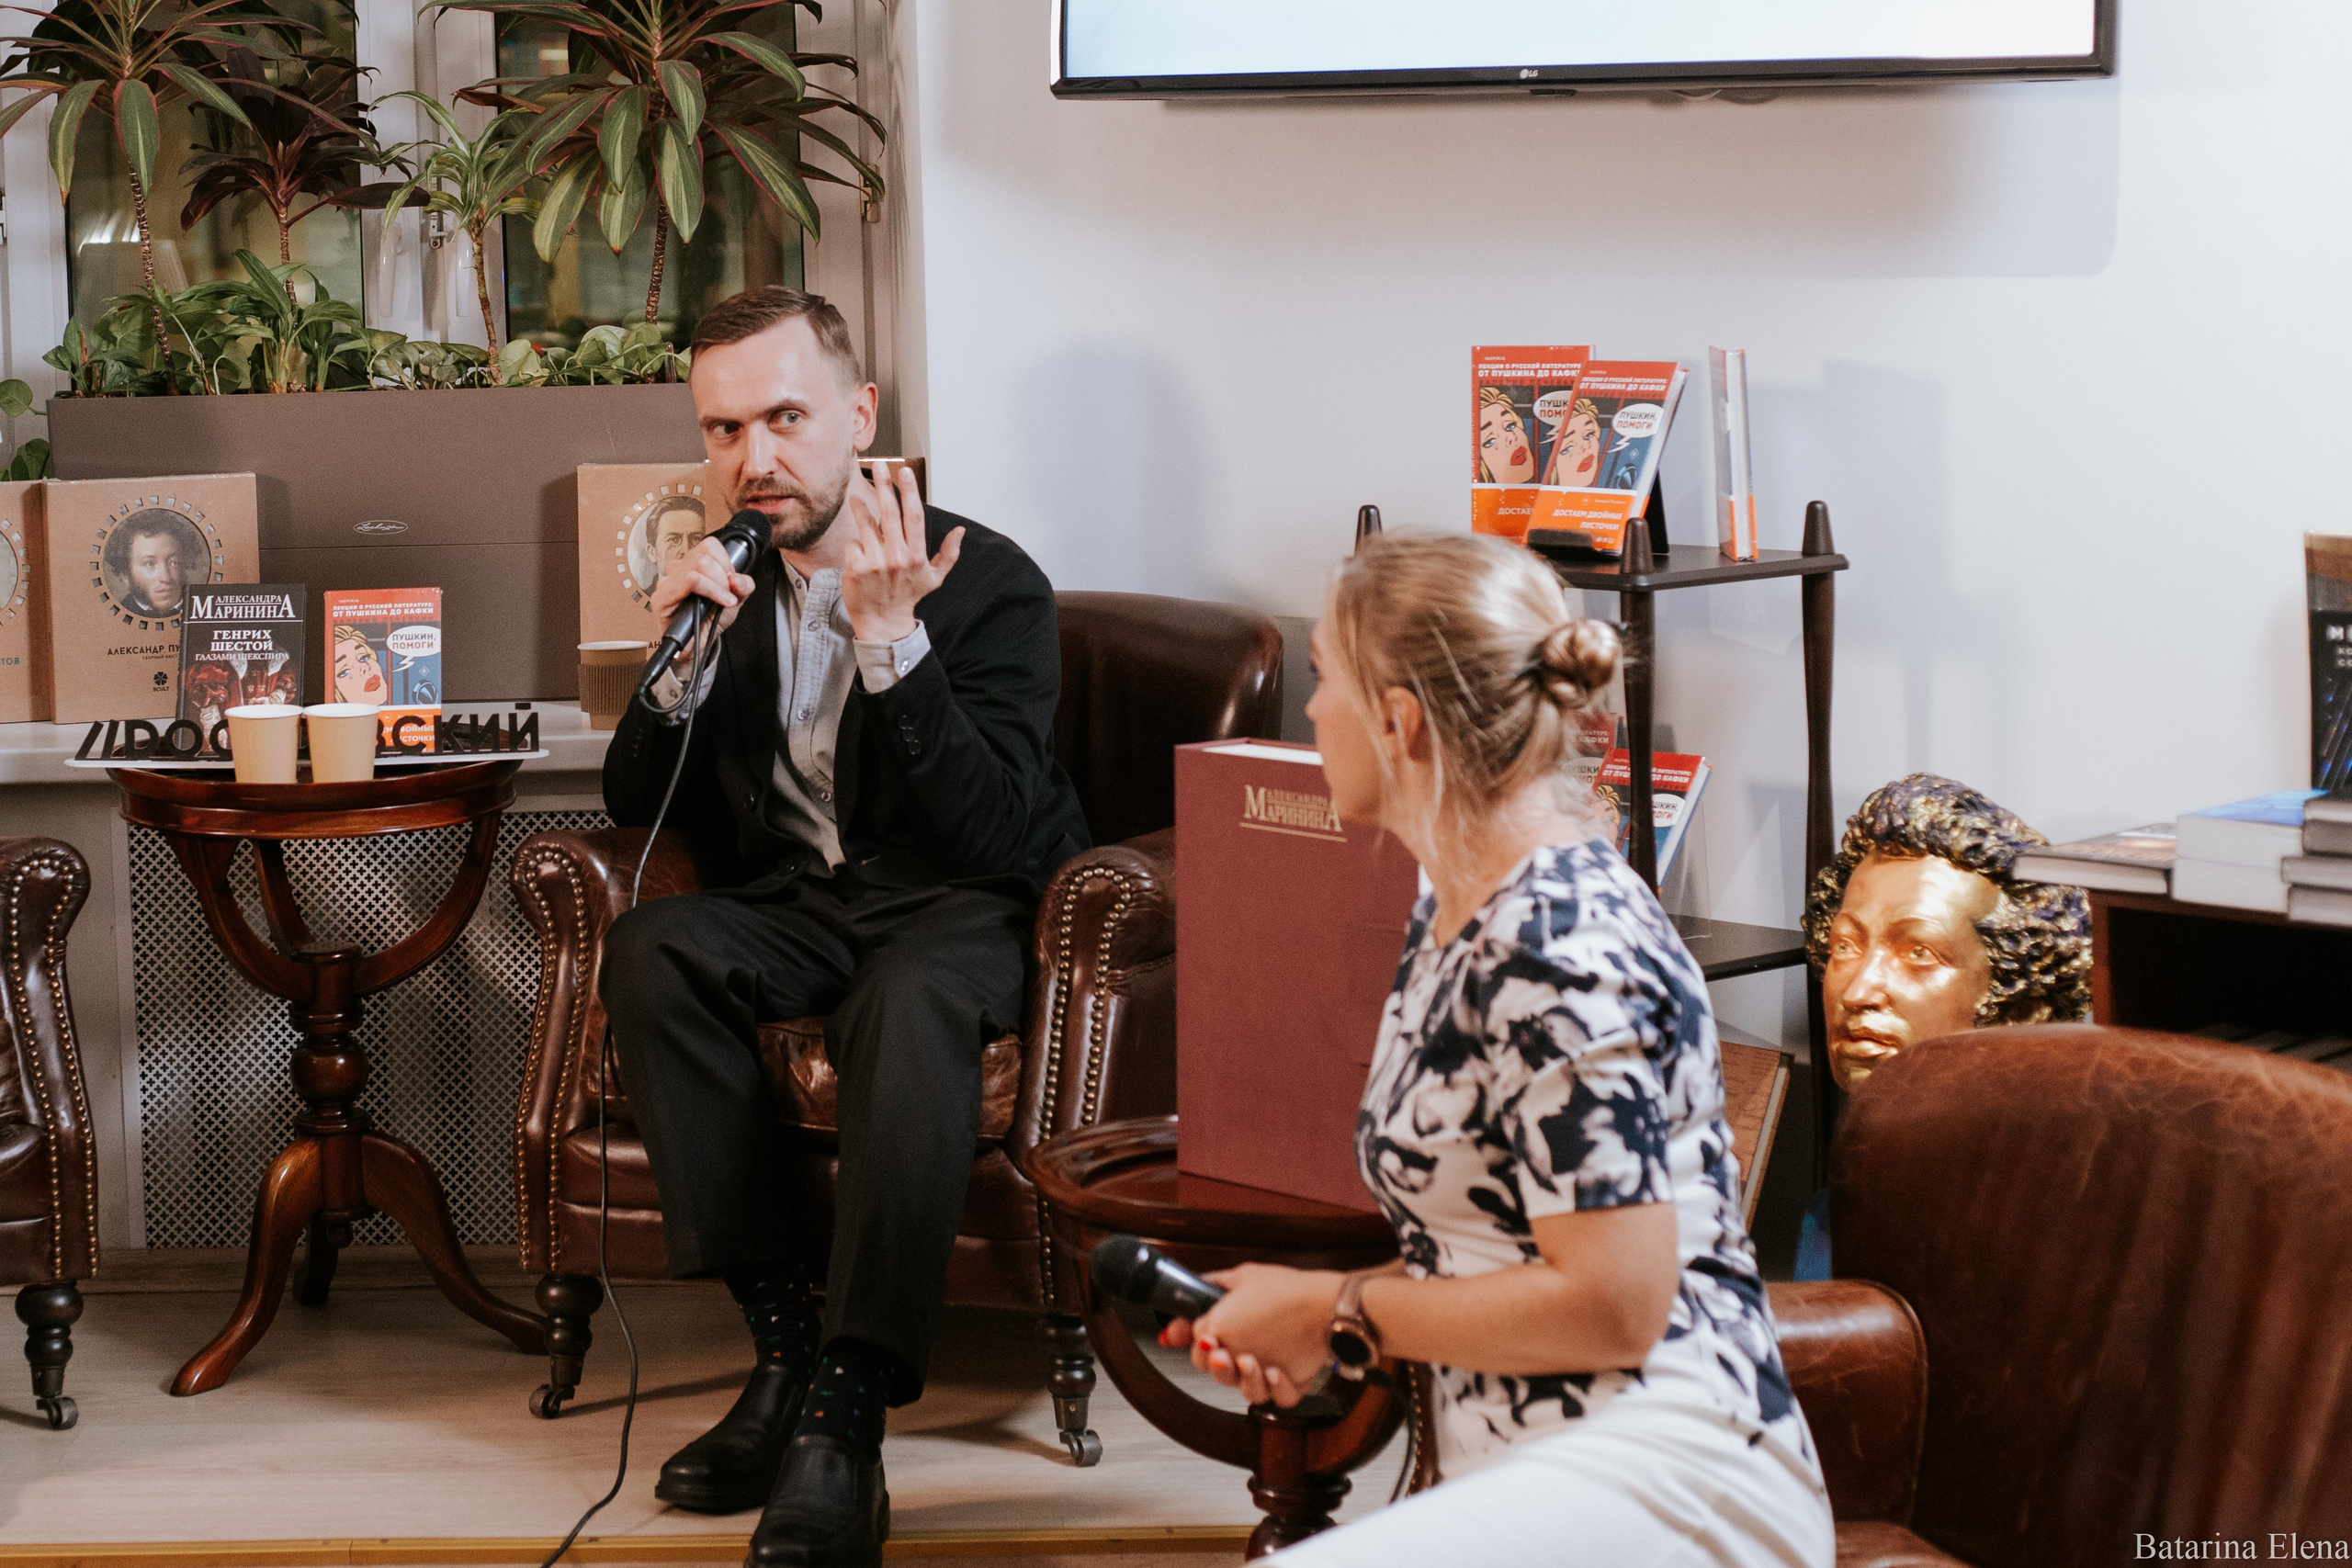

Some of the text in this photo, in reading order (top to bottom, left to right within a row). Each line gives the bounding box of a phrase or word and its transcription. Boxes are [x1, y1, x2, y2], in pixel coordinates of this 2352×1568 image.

[1477, 369, 1489, 378] ОТ
[1491, 369, 1535, 378] ПУШКИНА
[1536, 369, 1550, 378] ДО
[1626, 383, 1638, 391] ДО
[1639, 383, 1667, 391] КАФКИ
[1540, 400, 1568, 408] ПУШК
[1619, 411, 1657, 421] ПУШКИН,
[1617, 420, 1653, 429] ПОМОГИ
[1553, 508, 1623, 520] ДОСТАЕМ ДВОЙНЫЕ
[1579, 521, 1620, 531] ЛИСТОЧКИ
[214, 594, 282, 604] АЛЕКСАНДРА
[190, 593, 296, 619] МАРИНИНА
[212, 629, 272, 641] ГЕНРИХ
[392, 633, 436, 641] ПУШКИН,
[210, 639, 274, 652] ШЕСТОЙ
[392, 641, 434, 649] ПОМОГИ
[107, 645, 164, 656] АЛЕКСАНДР
[195, 652, 289, 661] ГЛАЗАМИ ШЕКСПИРА
[1602, 769, 1613, 777] ОТ
[1663, 774, 1690, 784] КАФКИ
